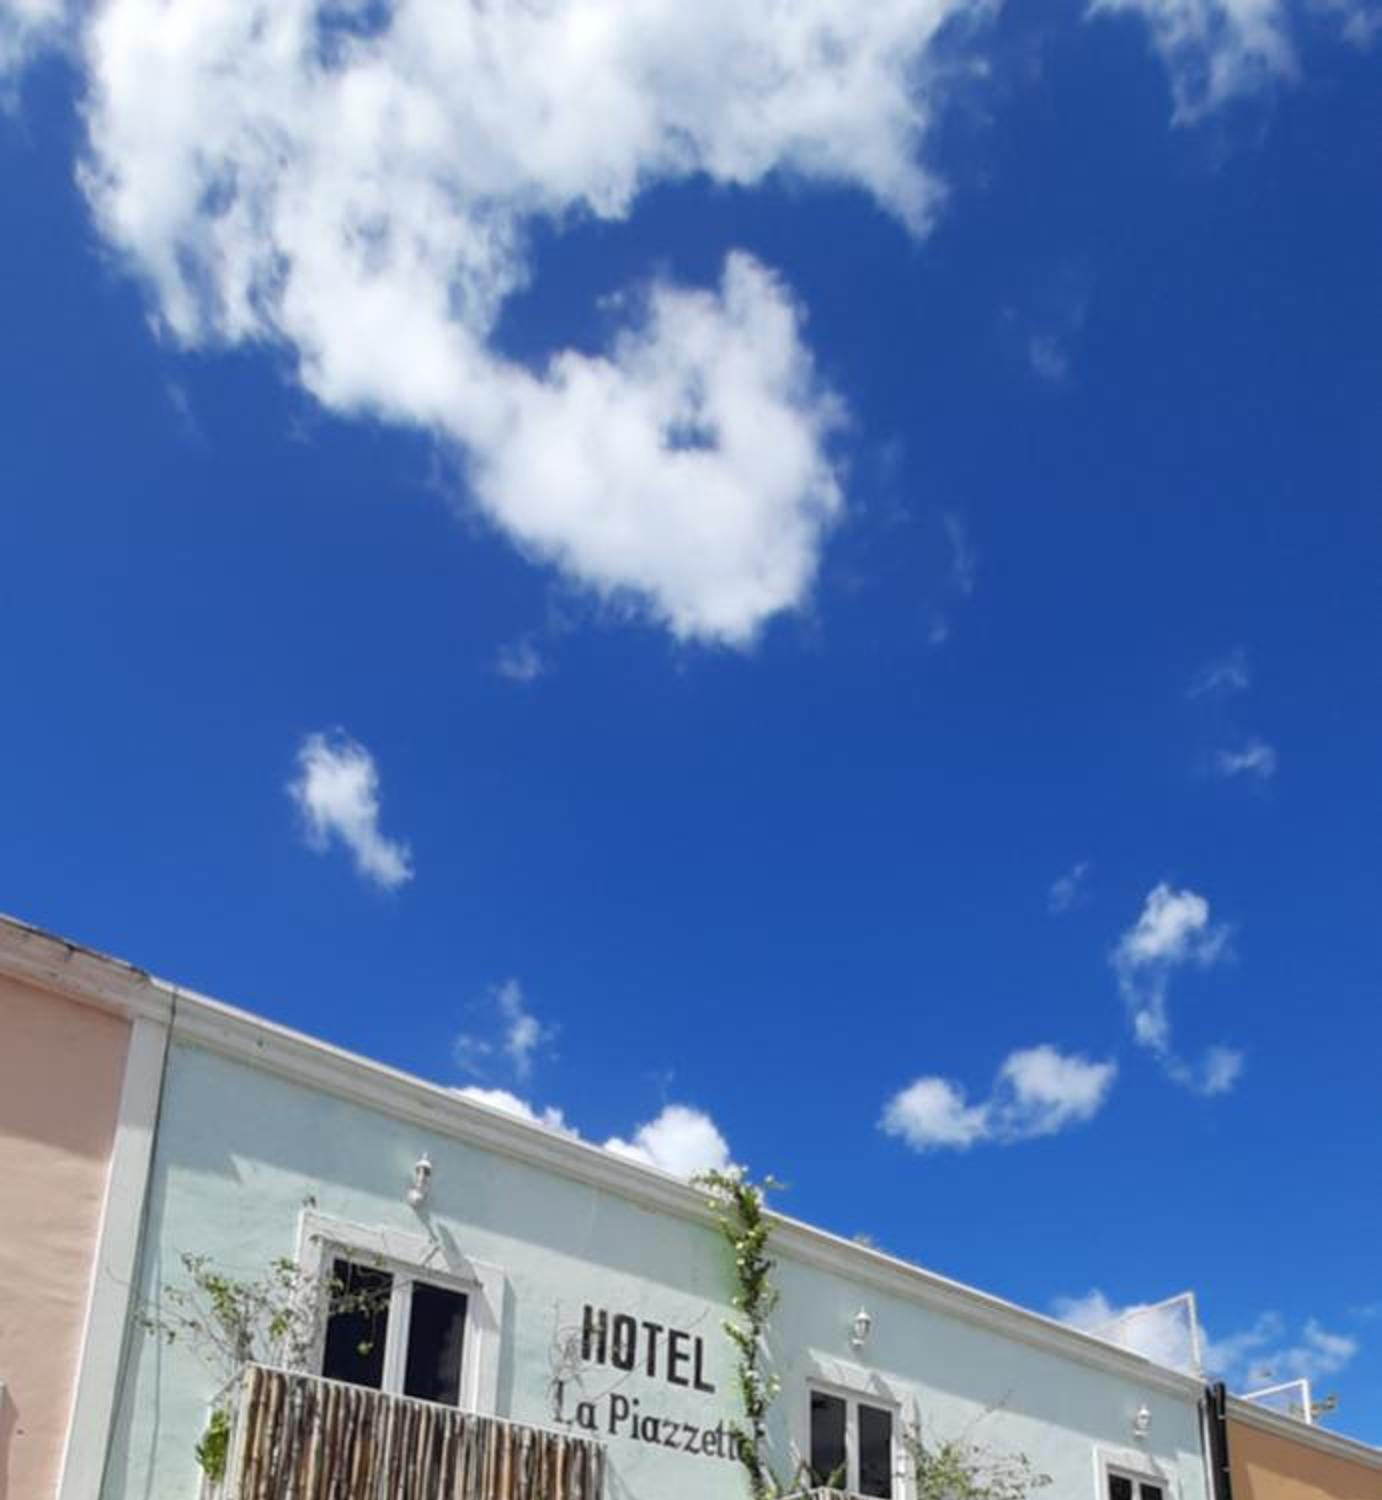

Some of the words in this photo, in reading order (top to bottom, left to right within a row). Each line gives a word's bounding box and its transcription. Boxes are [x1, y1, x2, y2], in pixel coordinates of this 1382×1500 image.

[581, 1304, 716, 1394] HOTEL
[553, 1379, 598, 1431] La
[608, 1393, 749, 1462] Piazzett
